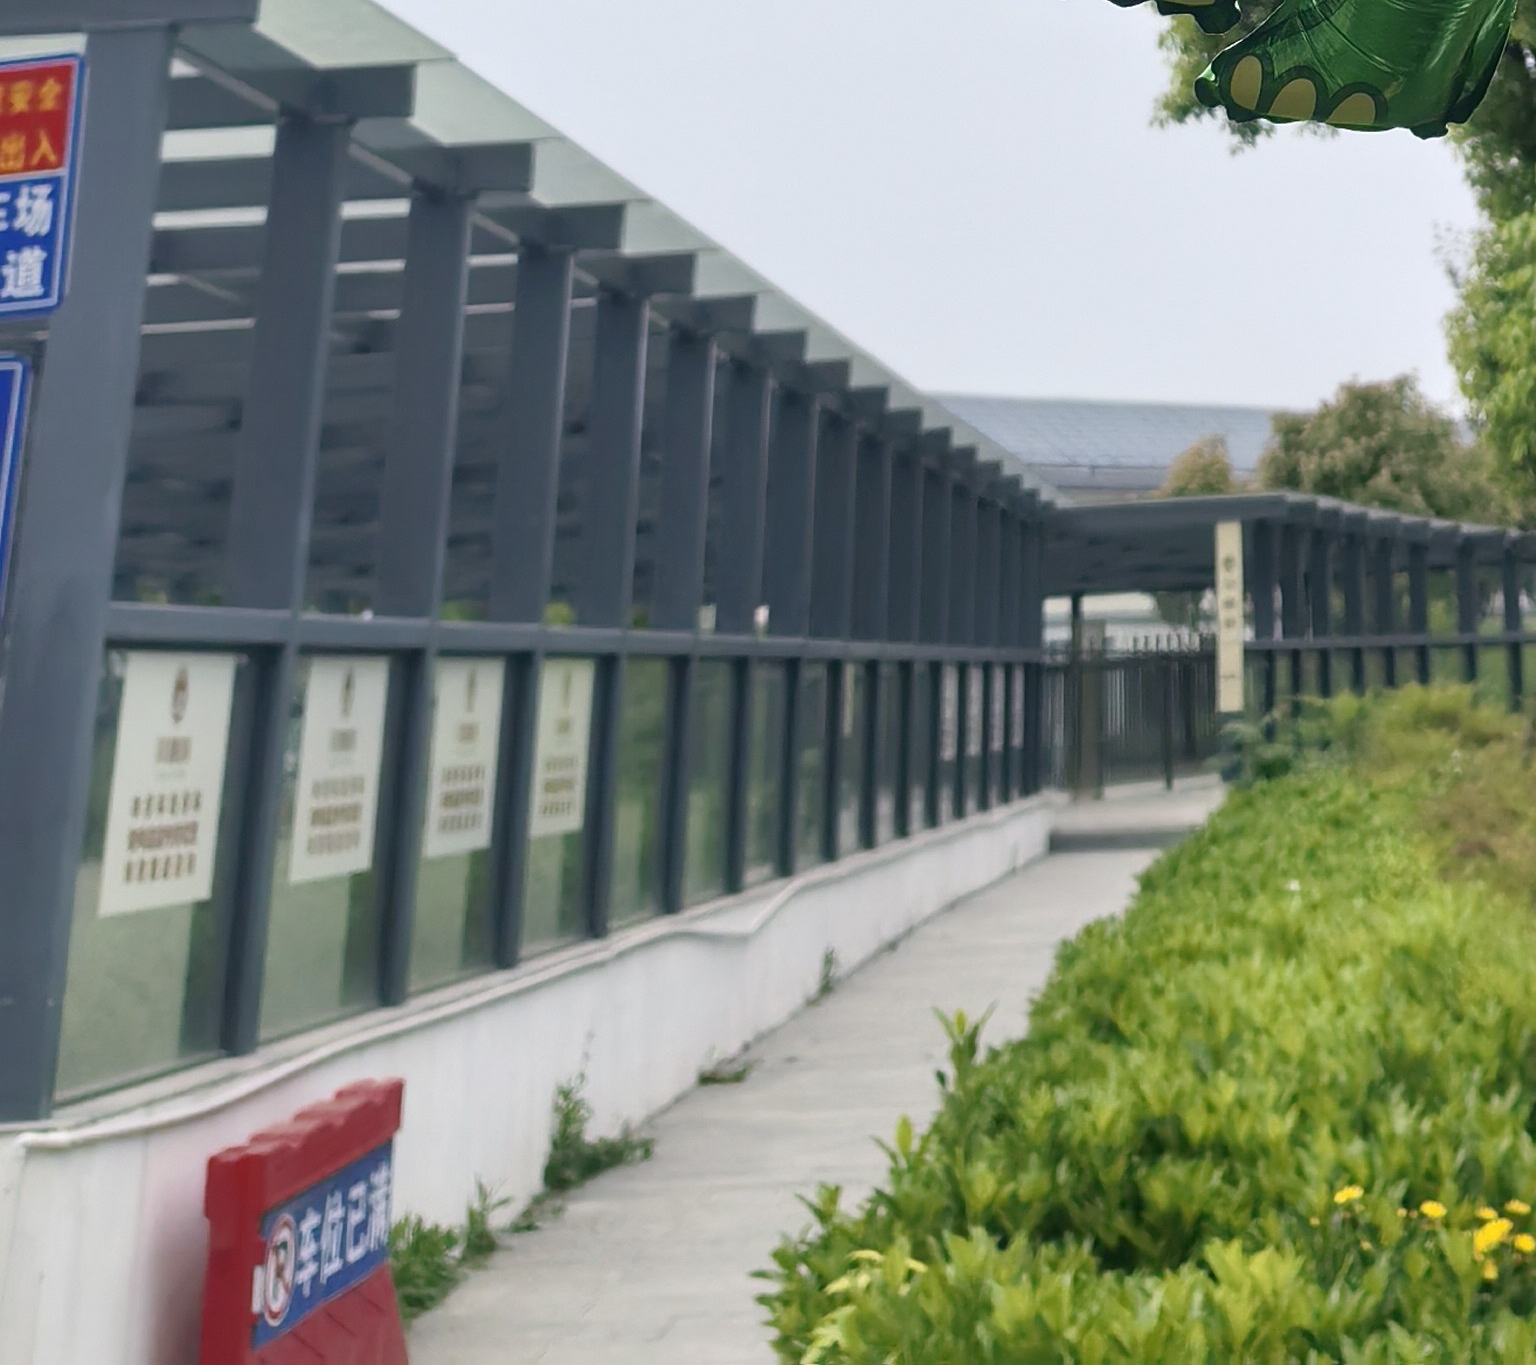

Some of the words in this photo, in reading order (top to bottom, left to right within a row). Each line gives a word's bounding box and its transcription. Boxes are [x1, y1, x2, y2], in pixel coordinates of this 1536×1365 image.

[0, 183, 53, 237] 场
[294, 1160, 391, 1297] 车位已满
